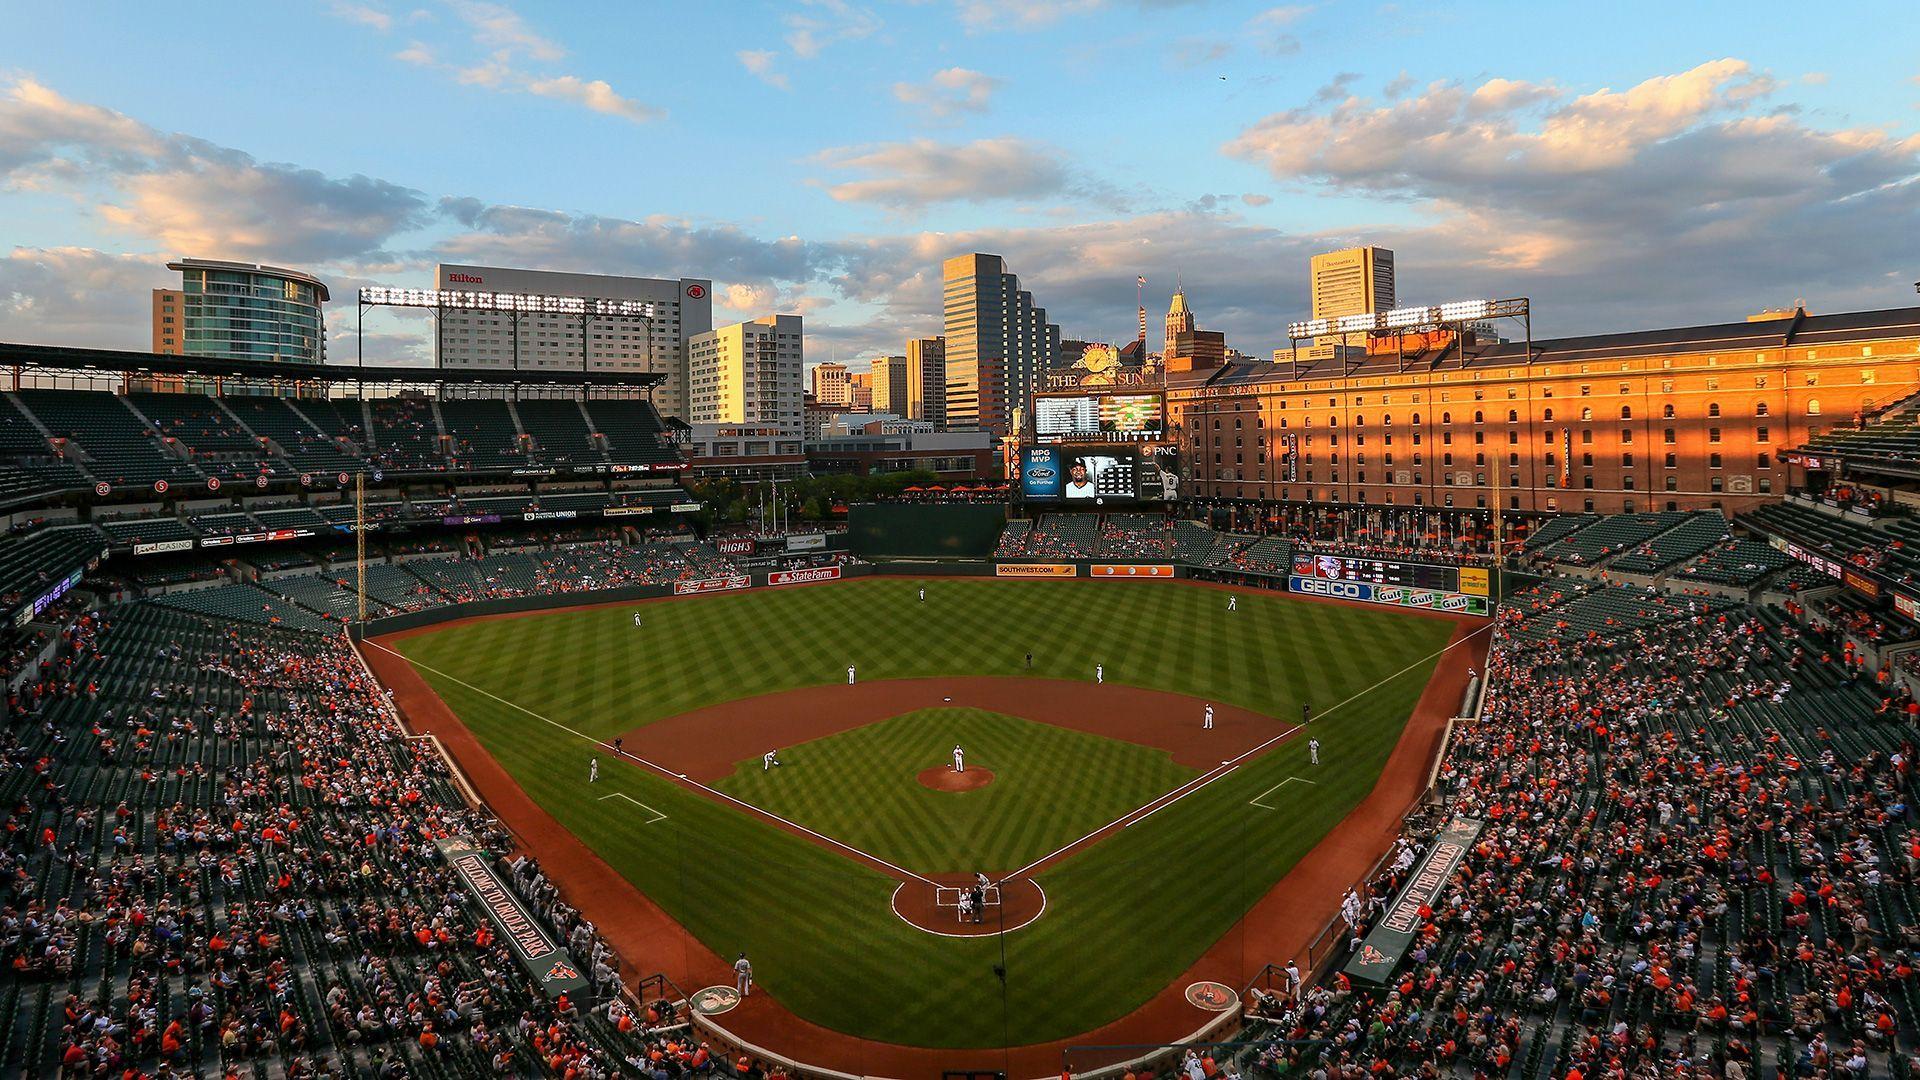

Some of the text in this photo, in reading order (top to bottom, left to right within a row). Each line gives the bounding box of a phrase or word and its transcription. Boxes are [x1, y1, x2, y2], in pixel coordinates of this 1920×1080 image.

[448, 273, 483, 284] Hilton
[1050, 373, 1145, 387] THE SUN
[1154, 446, 1177, 456] PNC
[1032, 468, 1051, 477] Ford
[98, 485, 109, 493] 20
[159, 482, 164, 490] 5
[555, 510, 577, 518] UNION
[158, 541, 192, 551] CASINO
[719, 541, 752, 553] HIGH'S
[999, 566, 1054, 574] SOUTHWEST.COM
[1300, 578, 1360, 598] GEICO
[1379, 590, 1402, 601] Gulf
[1410, 593, 1433, 605] Gulf
[1442, 597, 1467, 609] Gulf
[1386, 842, 1459, 932] HOME OF THE ORIOLES
[458, 856, 551, 958] WELCOME TO ORIOLE PARK
